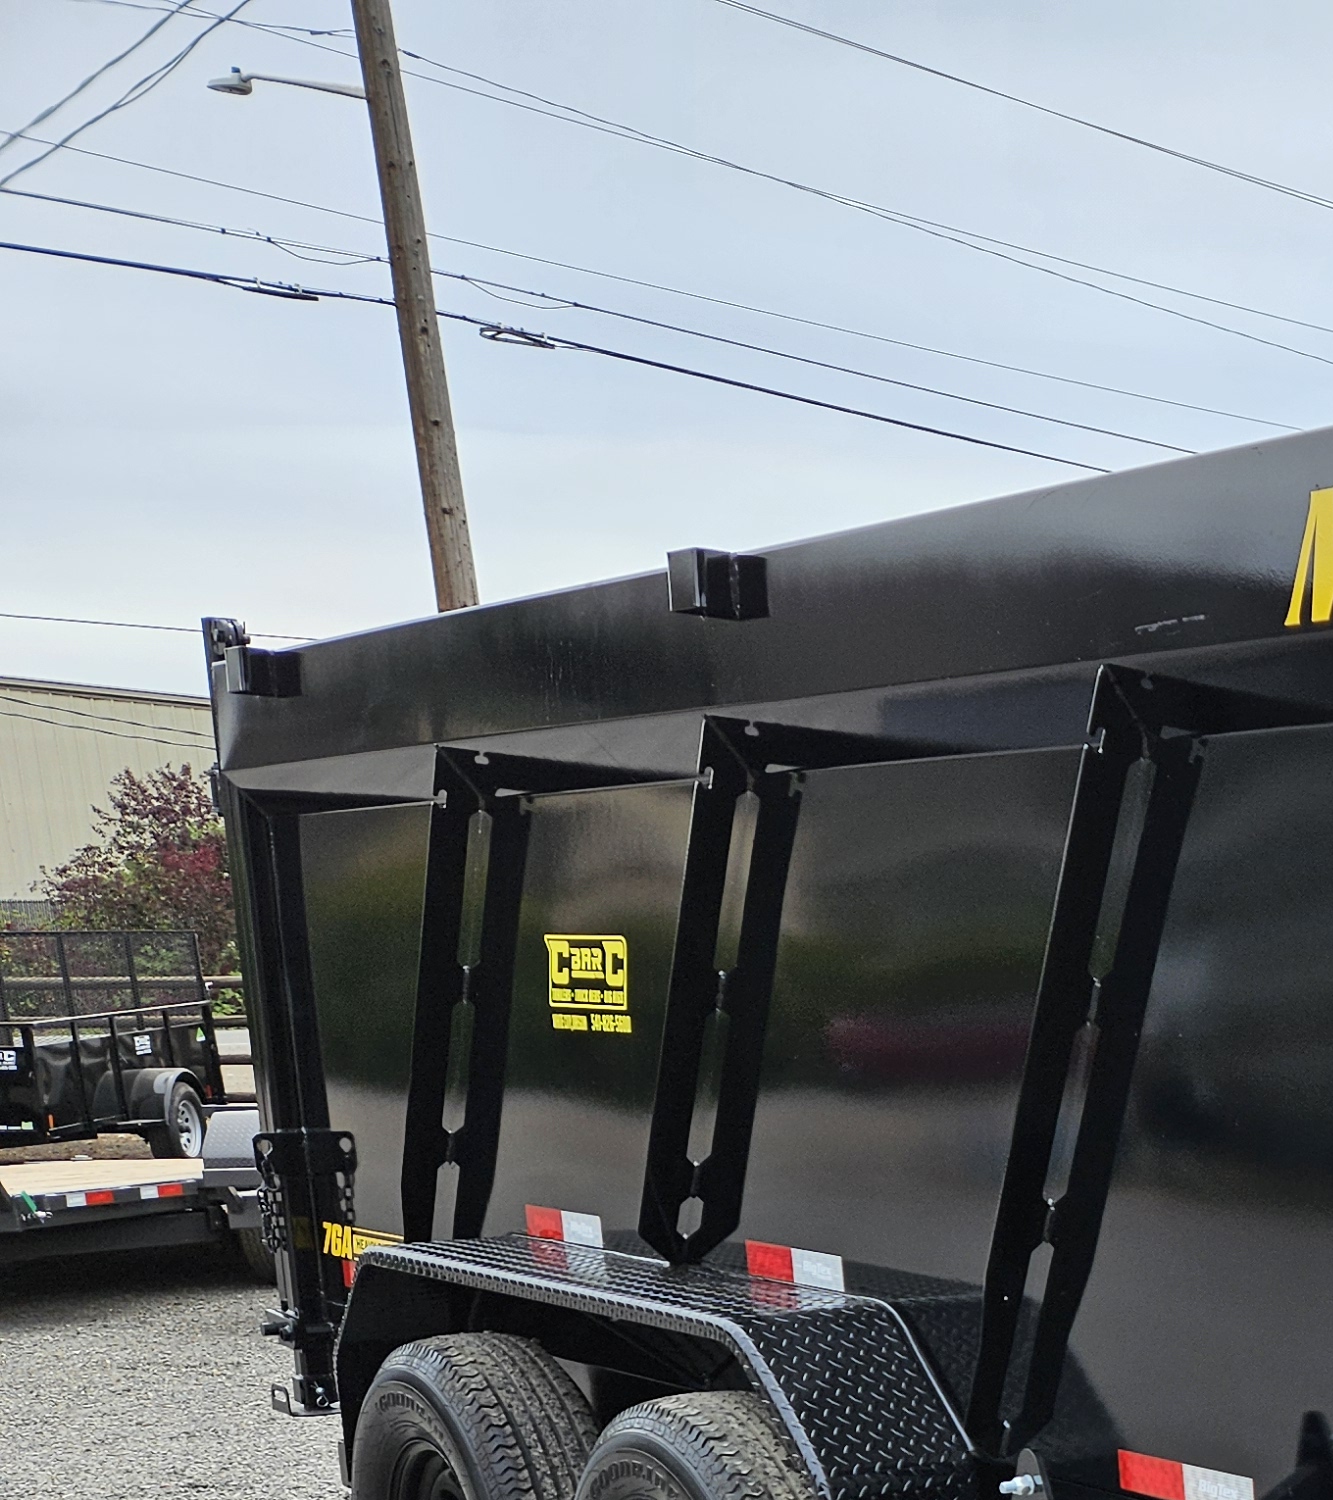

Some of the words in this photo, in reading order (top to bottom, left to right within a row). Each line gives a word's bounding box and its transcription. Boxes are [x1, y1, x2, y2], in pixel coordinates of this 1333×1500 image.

[548, 940, 570, 985] C
[569, 947, 603, 971] BAR
[602, 940, 625, 987] C
[322, 1221, 353, 1260] 7GA
[1197, 1479, 1239, 1499] BigTex
